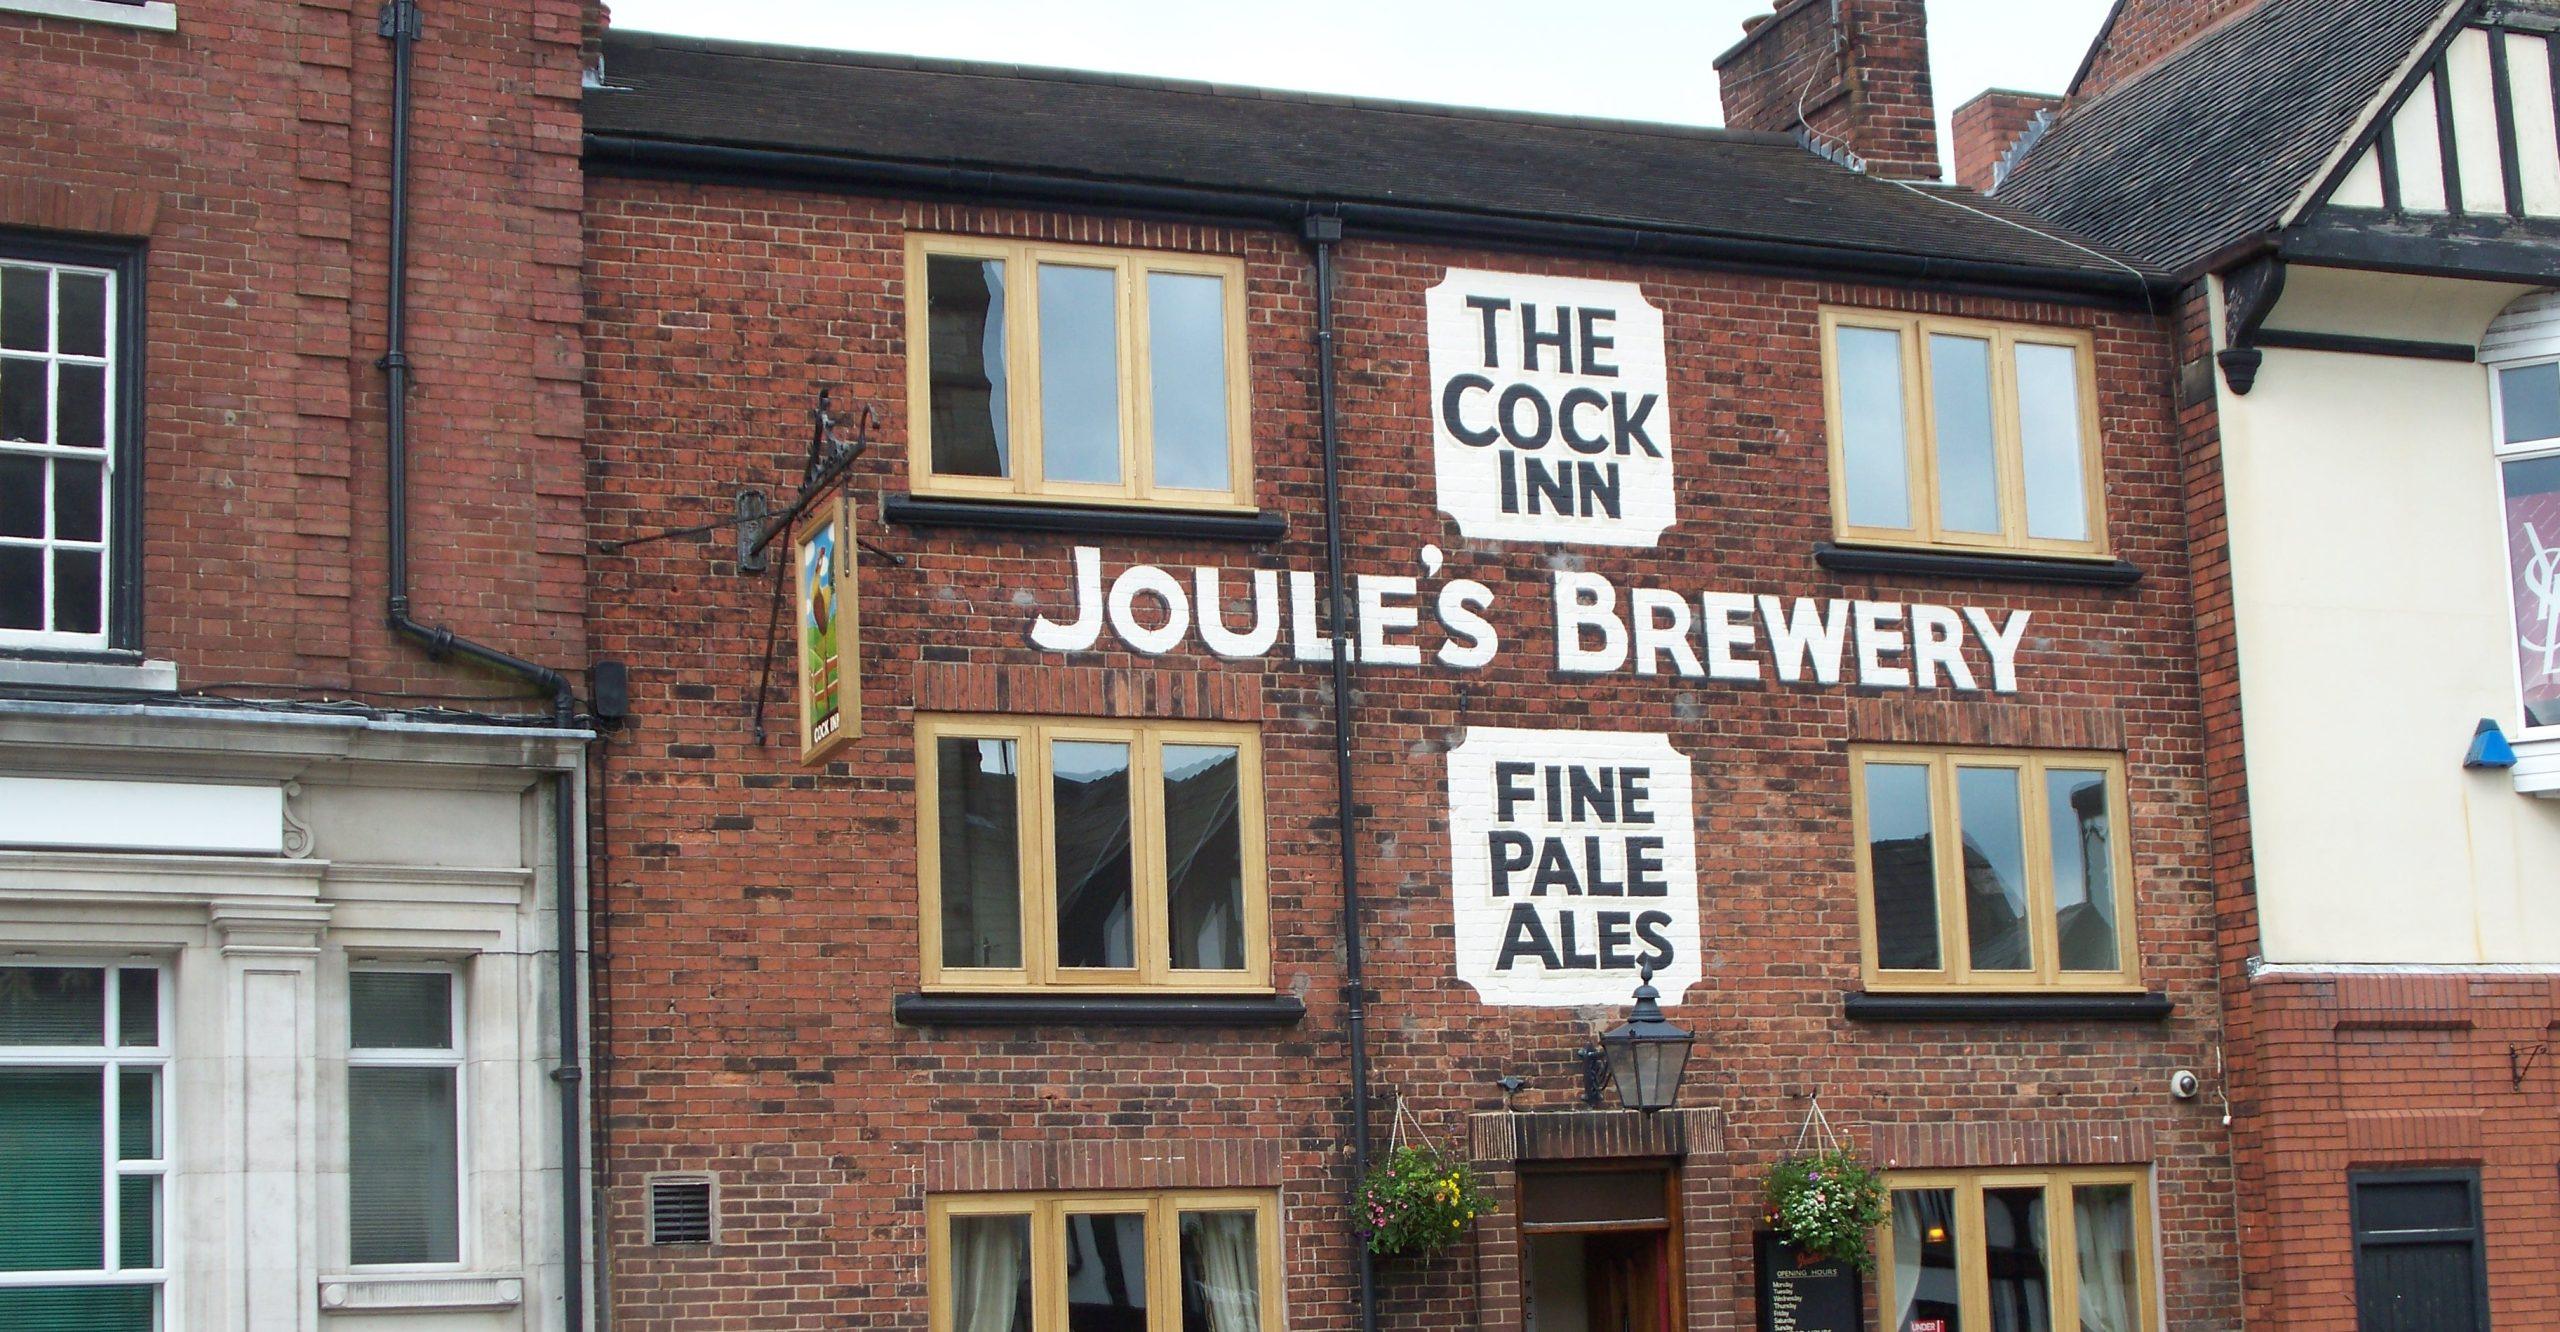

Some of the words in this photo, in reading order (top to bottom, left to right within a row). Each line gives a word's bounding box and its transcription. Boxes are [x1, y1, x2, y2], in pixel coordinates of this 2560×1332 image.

[1466, 294, 1619, 377] THE
[1441, 374, 1664, 458] COCK
[1500, 450, 1622, 519] INN
[1030, 546, 1499, 667] JOULE'S
[1554, 571, 2033, 693] BREWERY
[814, 719, 830, 743] COCK
[1494, 760, 1656, 825] FINE
[1488, 830, 1668, 898] PALE
[1495, 902, 1675, 972] ALES
[1911, 1322, 1936, 1331] UNDER
